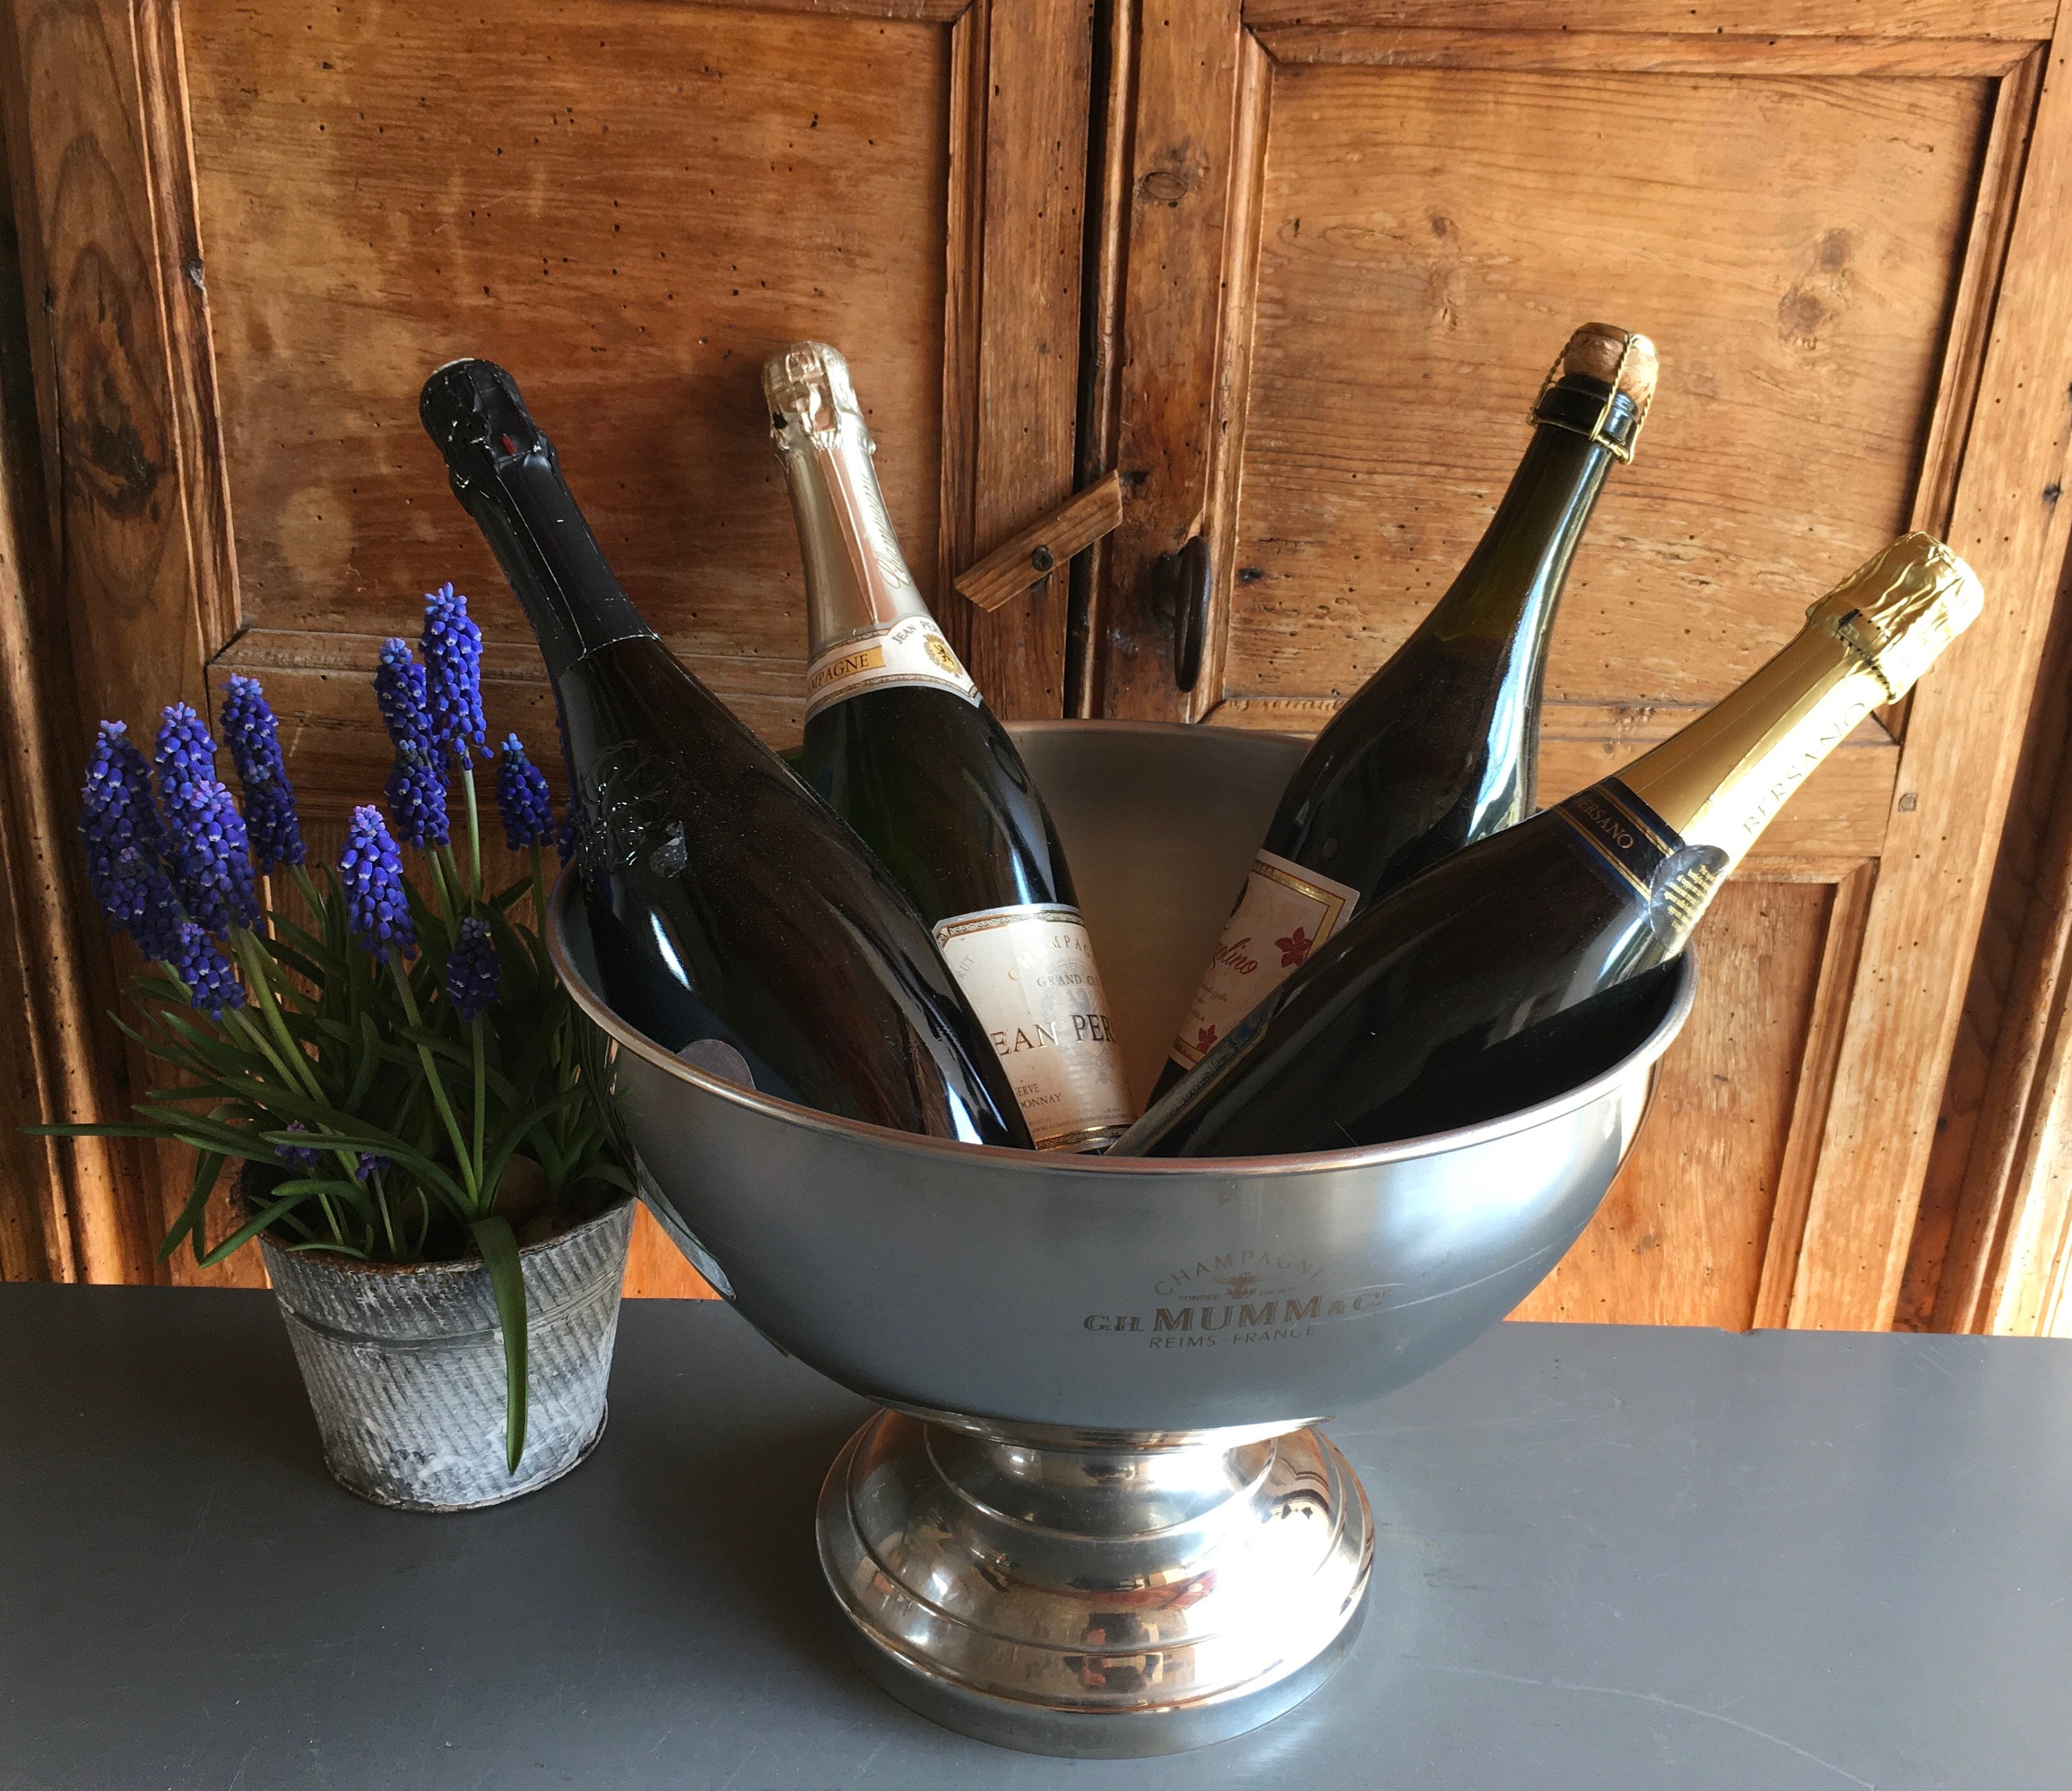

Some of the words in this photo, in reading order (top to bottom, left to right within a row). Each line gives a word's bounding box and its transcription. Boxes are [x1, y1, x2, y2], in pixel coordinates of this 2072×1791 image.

[892, 624, 917, 645] JEAN
[1575, 796, 1634, 849] BERSANO
[1037, 974, 1082, 987] GRAND
[1015, 1082, 1040, 1098] ERVE
[1154, 1249, 1325, 1296] CHAMPAGNE
[1153, 1294, 1323, 1332] MUMM
[1149, 1334, 1216, 1349] REIMS
[1232, 1323, 1316, 1345] FRANCE
